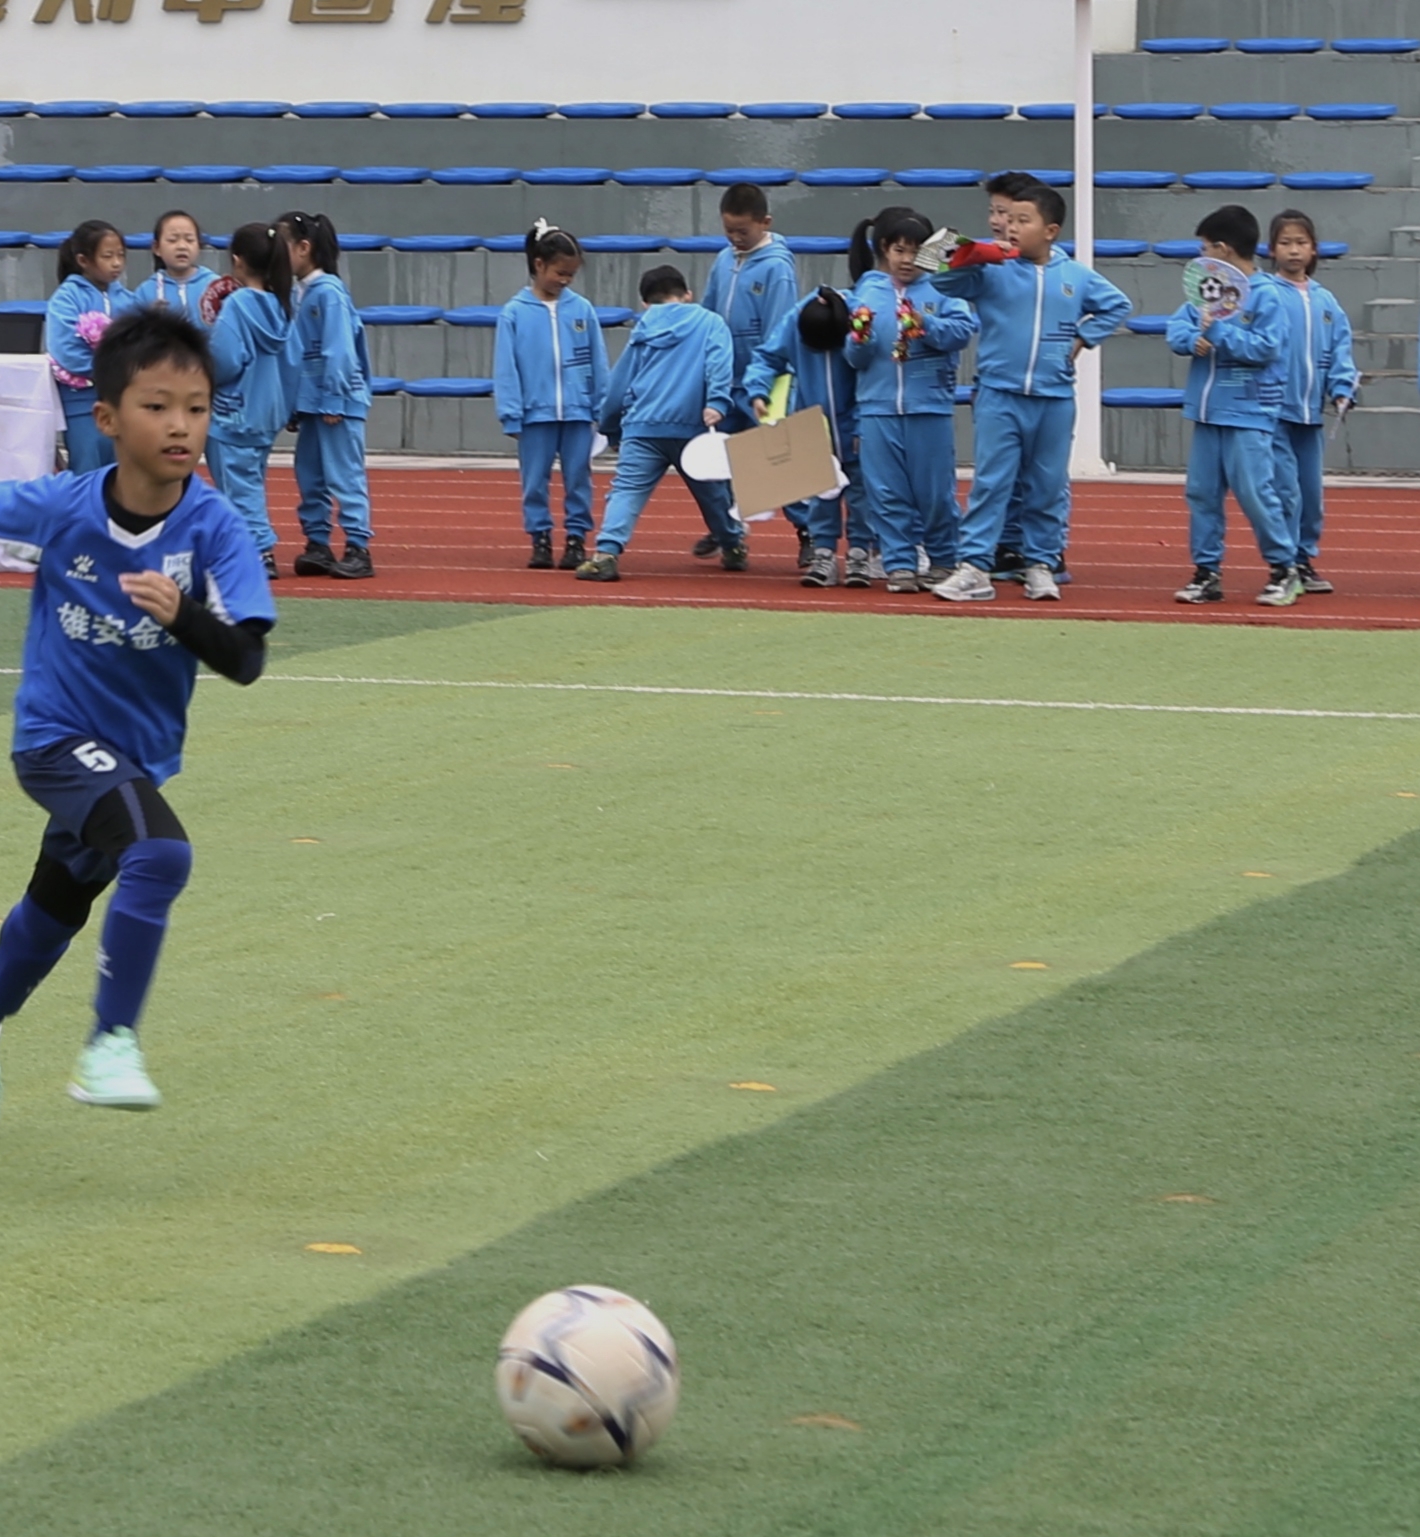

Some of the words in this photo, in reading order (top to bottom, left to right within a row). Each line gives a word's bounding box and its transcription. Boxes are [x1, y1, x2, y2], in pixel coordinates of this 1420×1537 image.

[65, 570, 99, 583] KELME
[57, 601, 179, 651] 雄安金
[71, 740, 118, 773] 5
